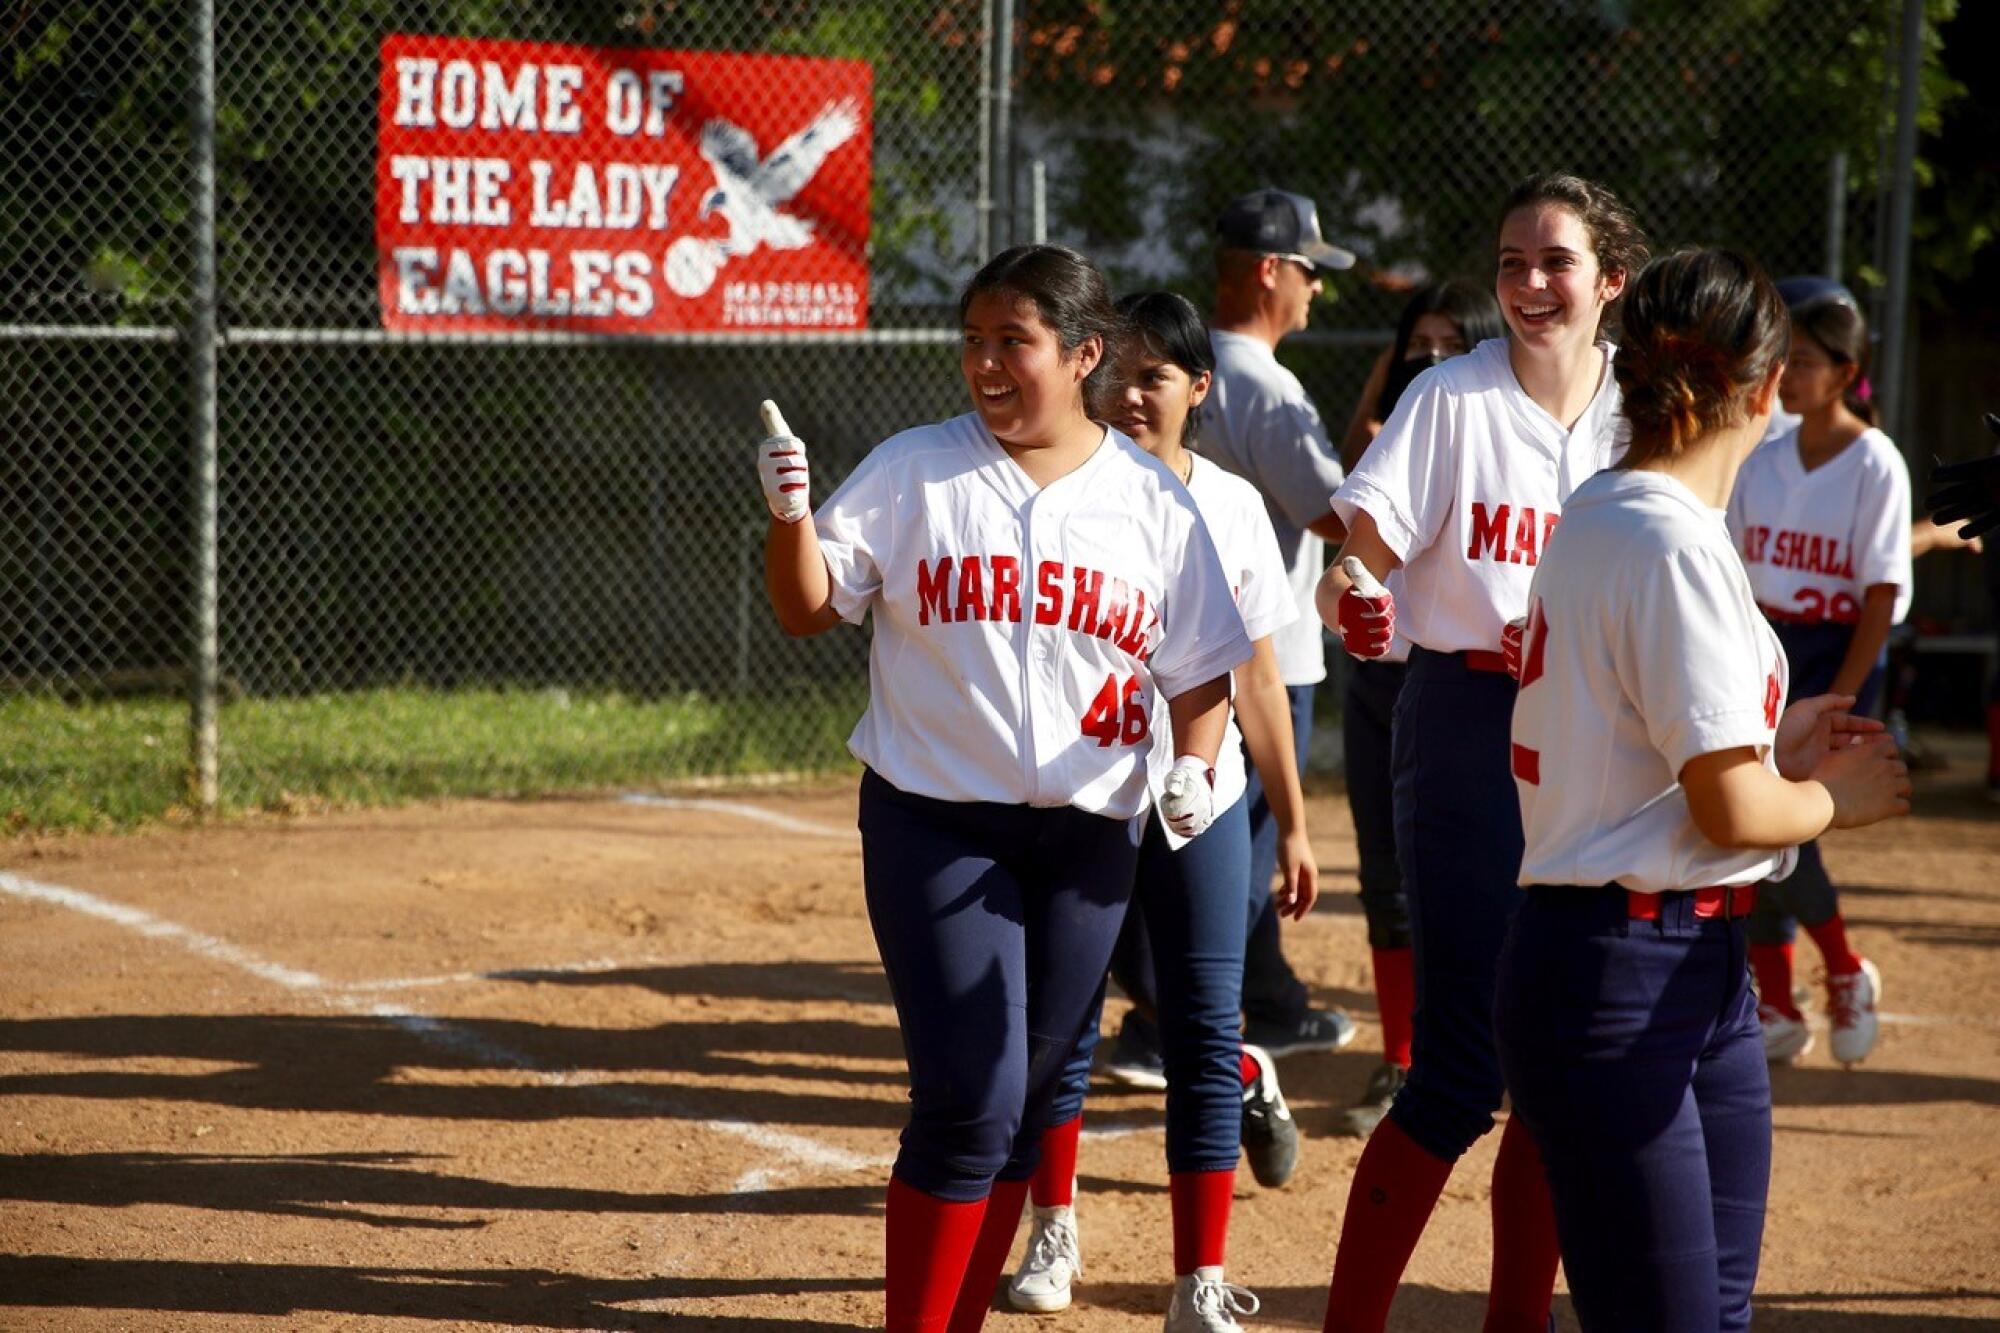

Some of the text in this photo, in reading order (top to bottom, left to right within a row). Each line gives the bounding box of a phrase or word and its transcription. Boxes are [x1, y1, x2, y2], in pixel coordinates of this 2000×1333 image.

[394, 56, 684, 138] HOME OF
[391, 154, 680, 231] THE LADY
[393, 246, 656, 318] EAGLES
[723, 281, 860, 304] MARSHALL
[1081, 672, 1148, 748] 46
